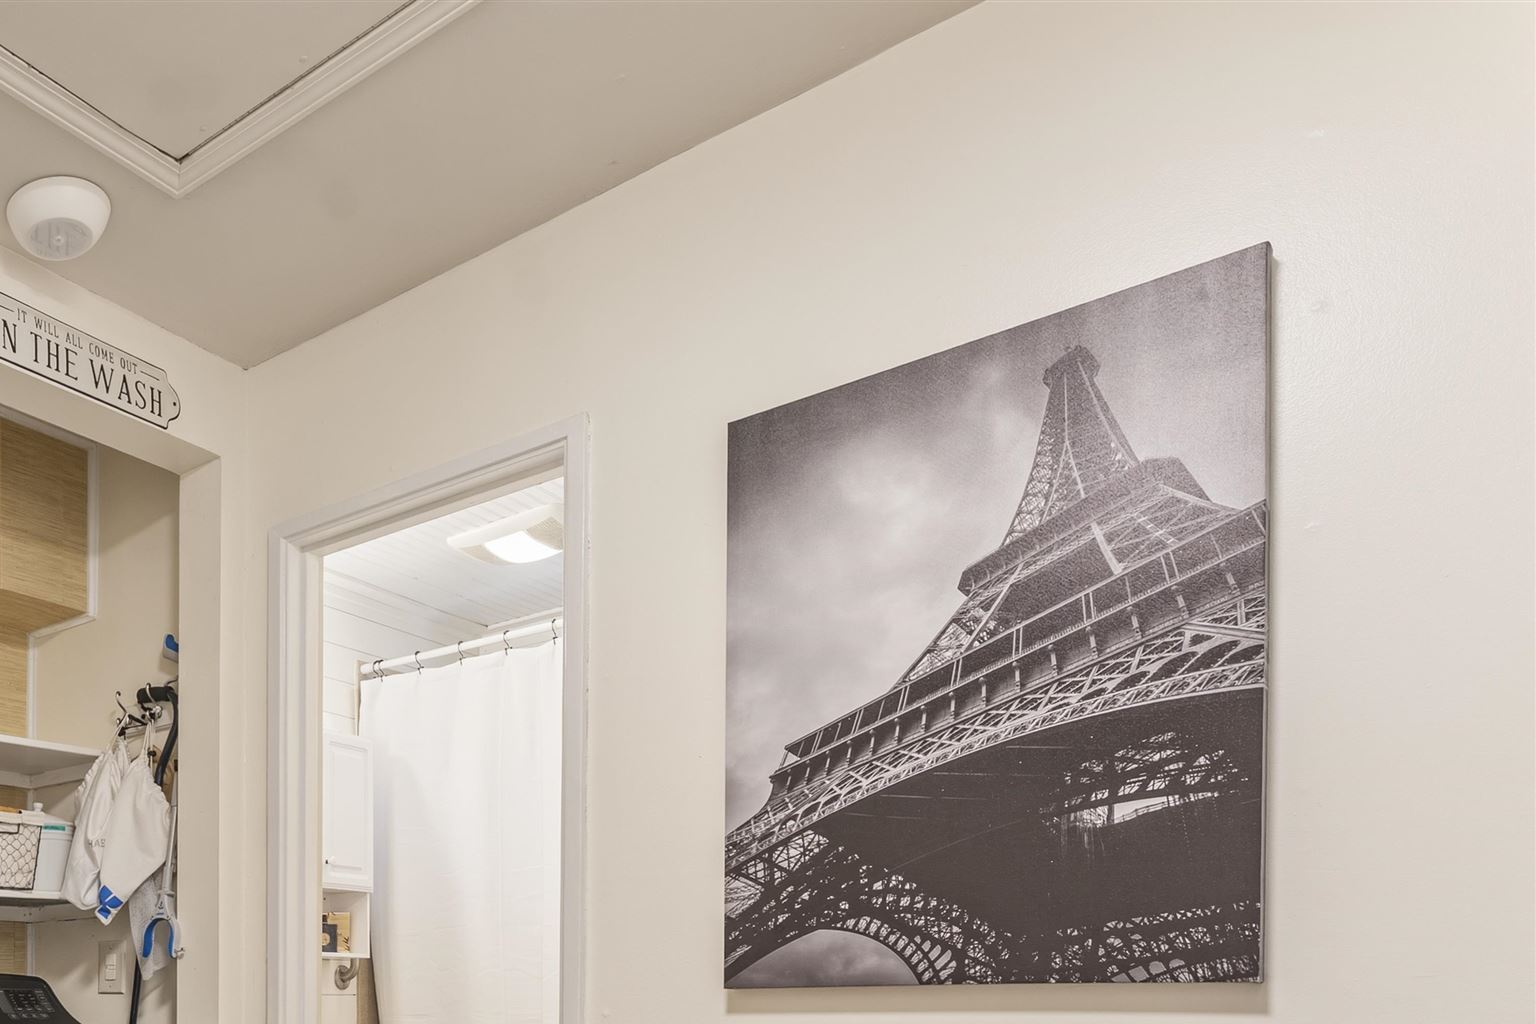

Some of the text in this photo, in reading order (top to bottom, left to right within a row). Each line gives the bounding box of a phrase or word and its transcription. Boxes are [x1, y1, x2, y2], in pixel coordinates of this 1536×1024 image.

[17, 308, 138, 375] IT WILL ALL COME OUT
[30, 331, 79, 381] THE
[89, 358, 163, 417] WASH
